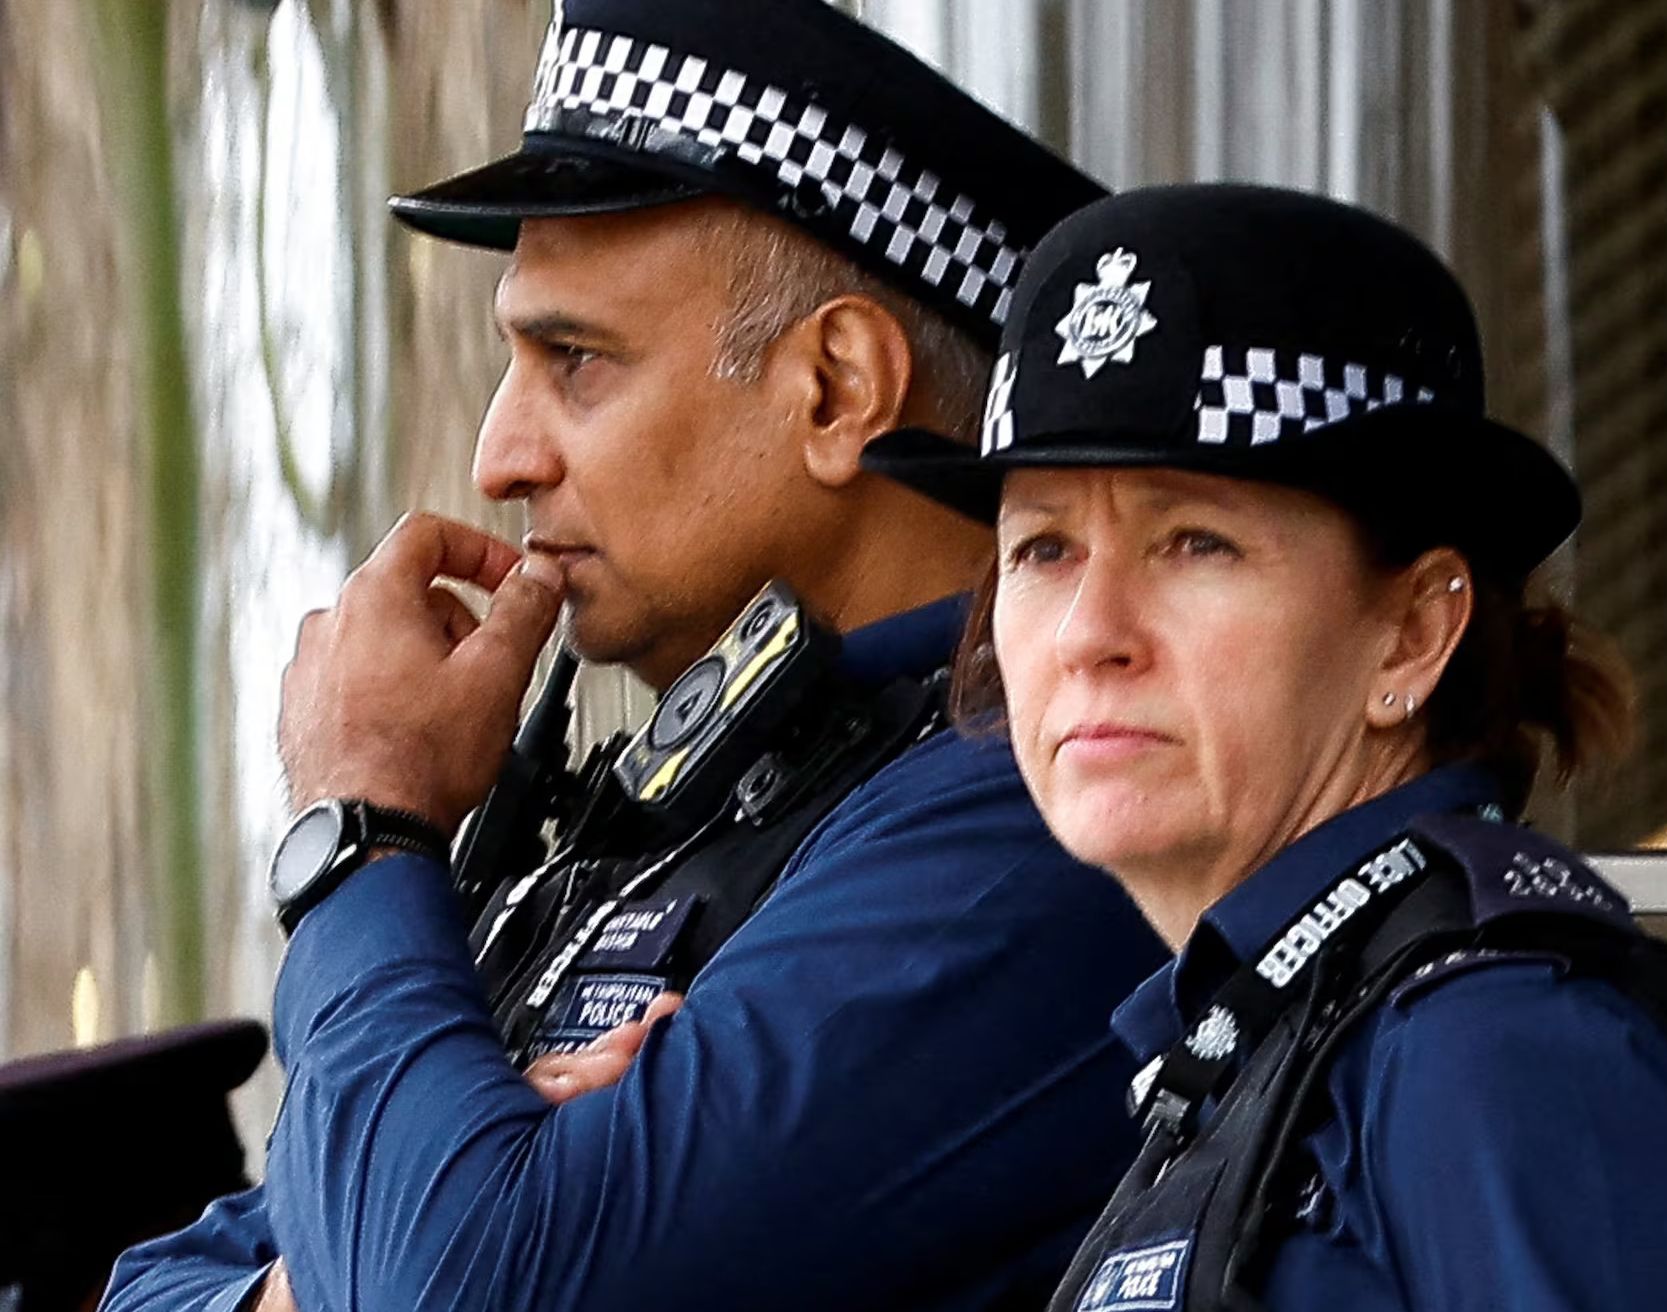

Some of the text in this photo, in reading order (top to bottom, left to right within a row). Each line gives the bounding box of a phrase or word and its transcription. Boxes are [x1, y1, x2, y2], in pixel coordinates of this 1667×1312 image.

[1358, 838, 1427, 894] LICE
[1256, 878, 1371, 989] OFFICER
[577, 1001, 639, 1027] POLICE
